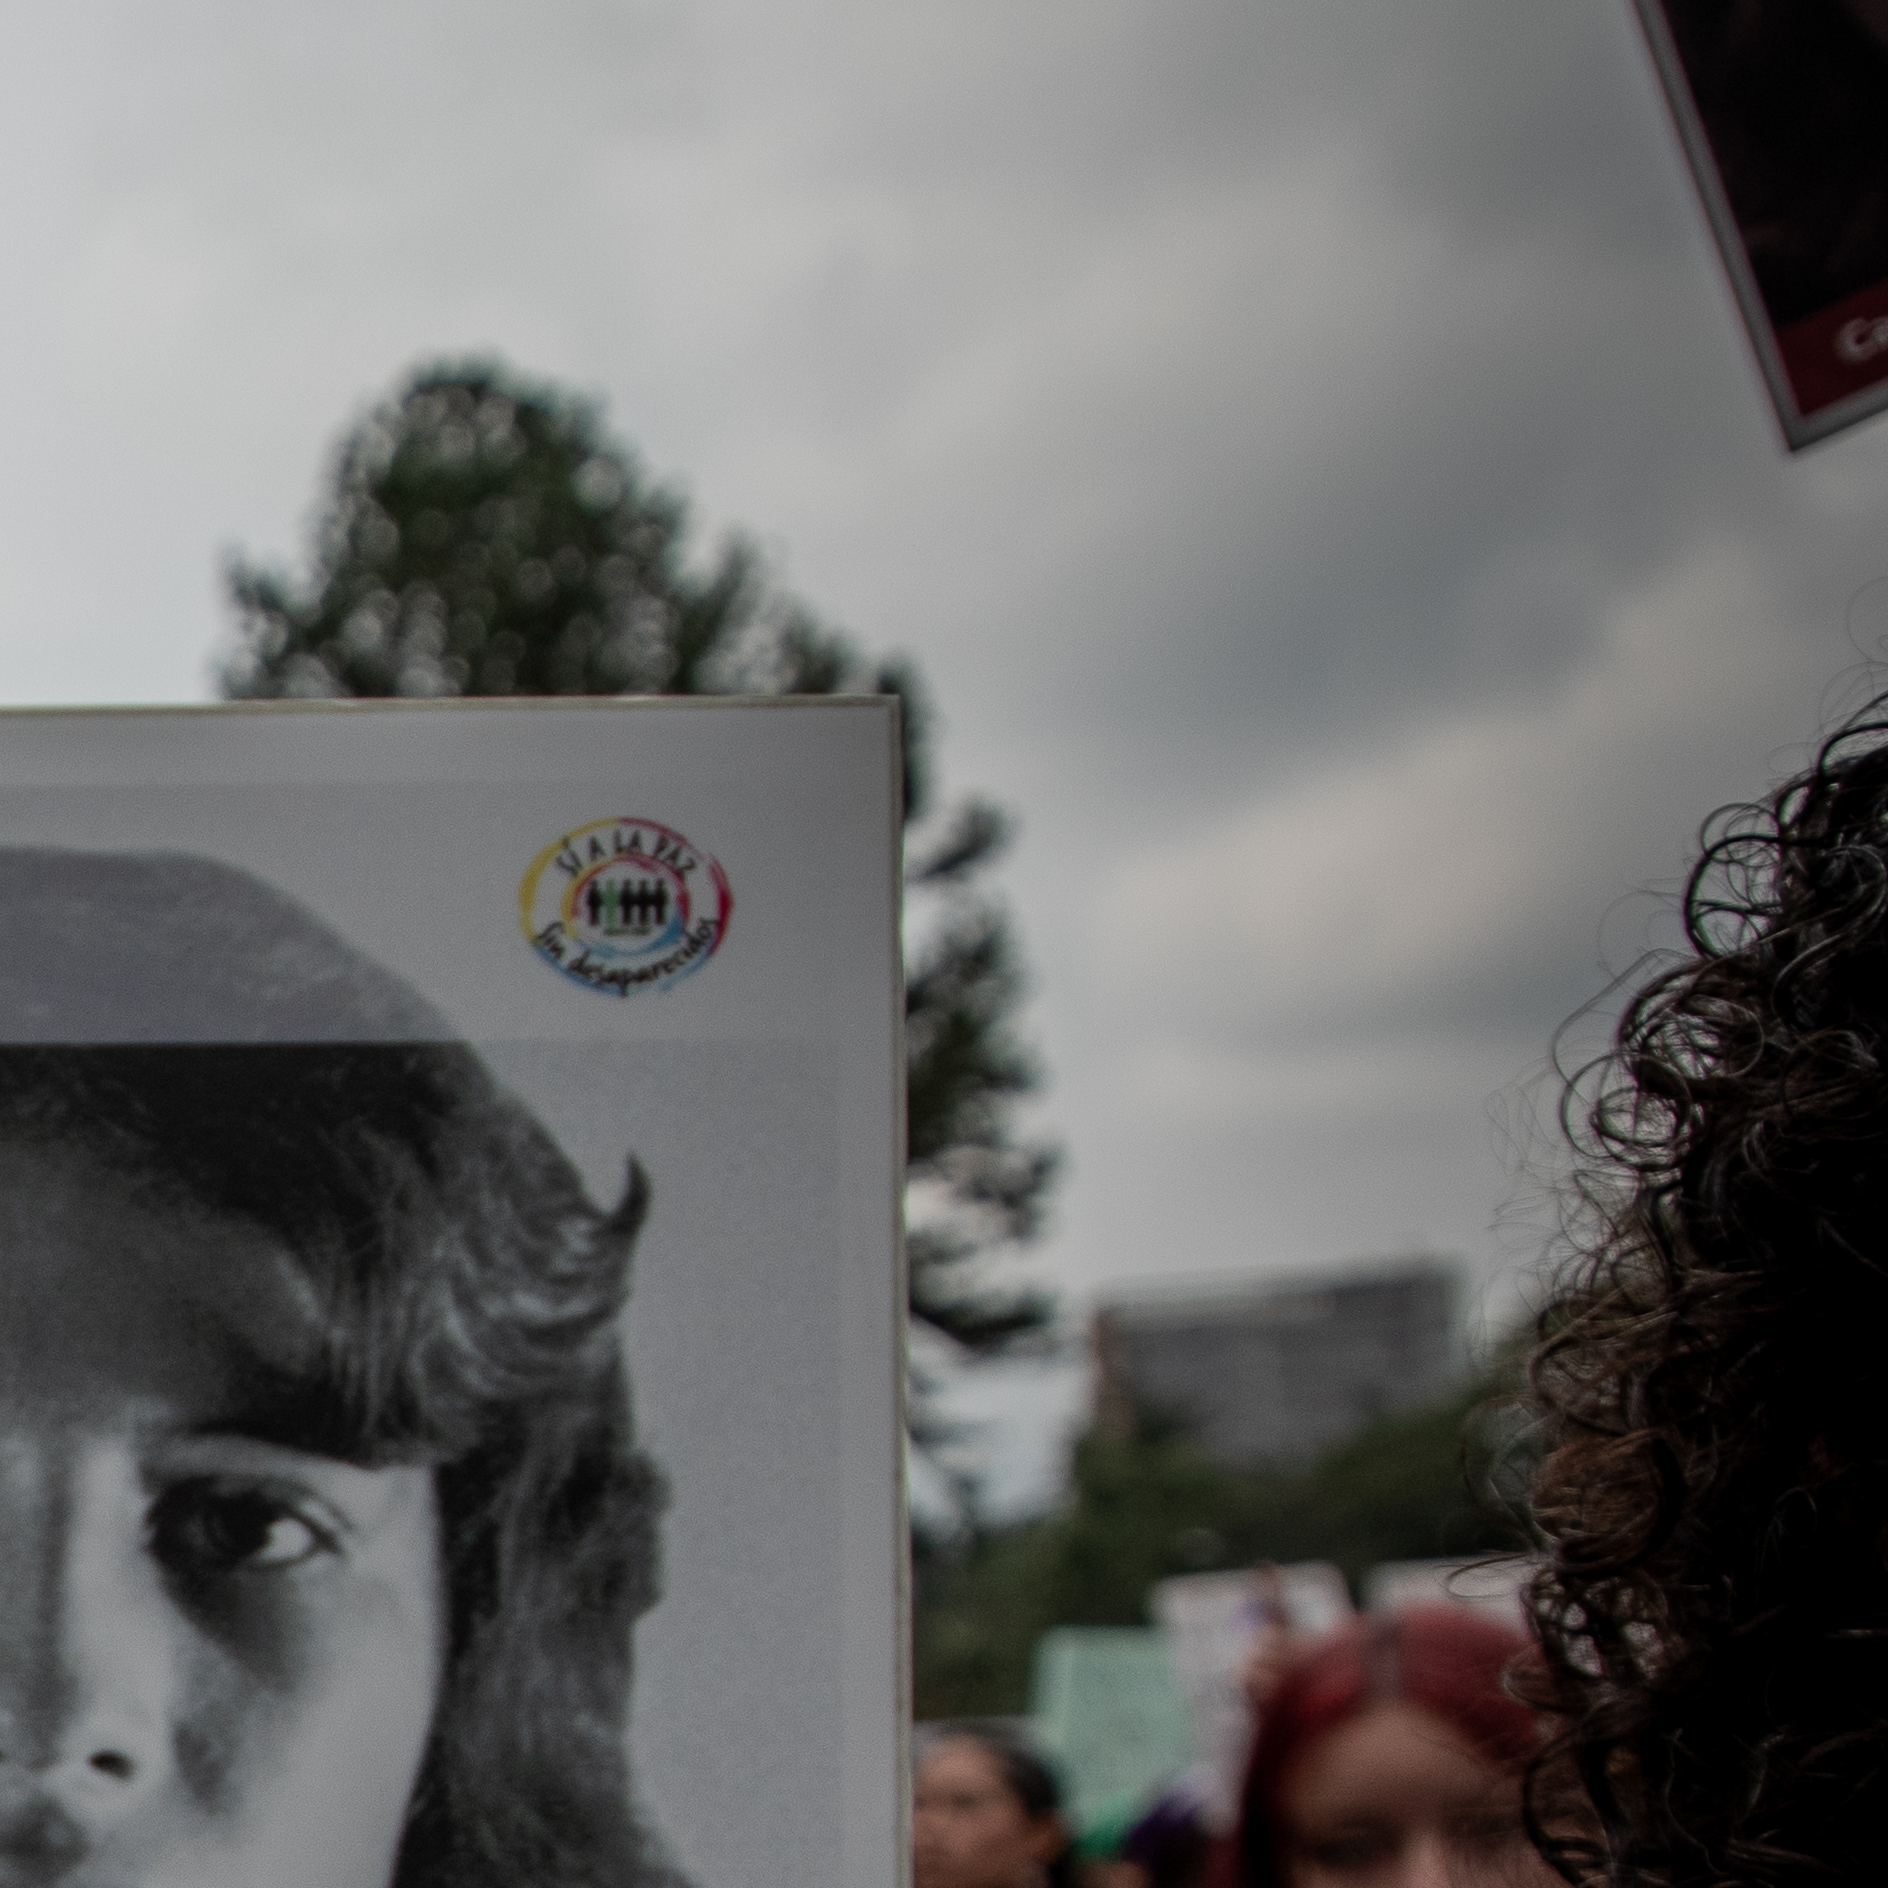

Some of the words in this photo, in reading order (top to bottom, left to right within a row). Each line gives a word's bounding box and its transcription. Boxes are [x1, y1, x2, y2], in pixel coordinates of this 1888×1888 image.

[589, 836, 605, 861] A
[614, 829, 644, 853] LA
[653, 836, 698, 878] PAZ
[568, 917, 720, 997] desaparecidos
